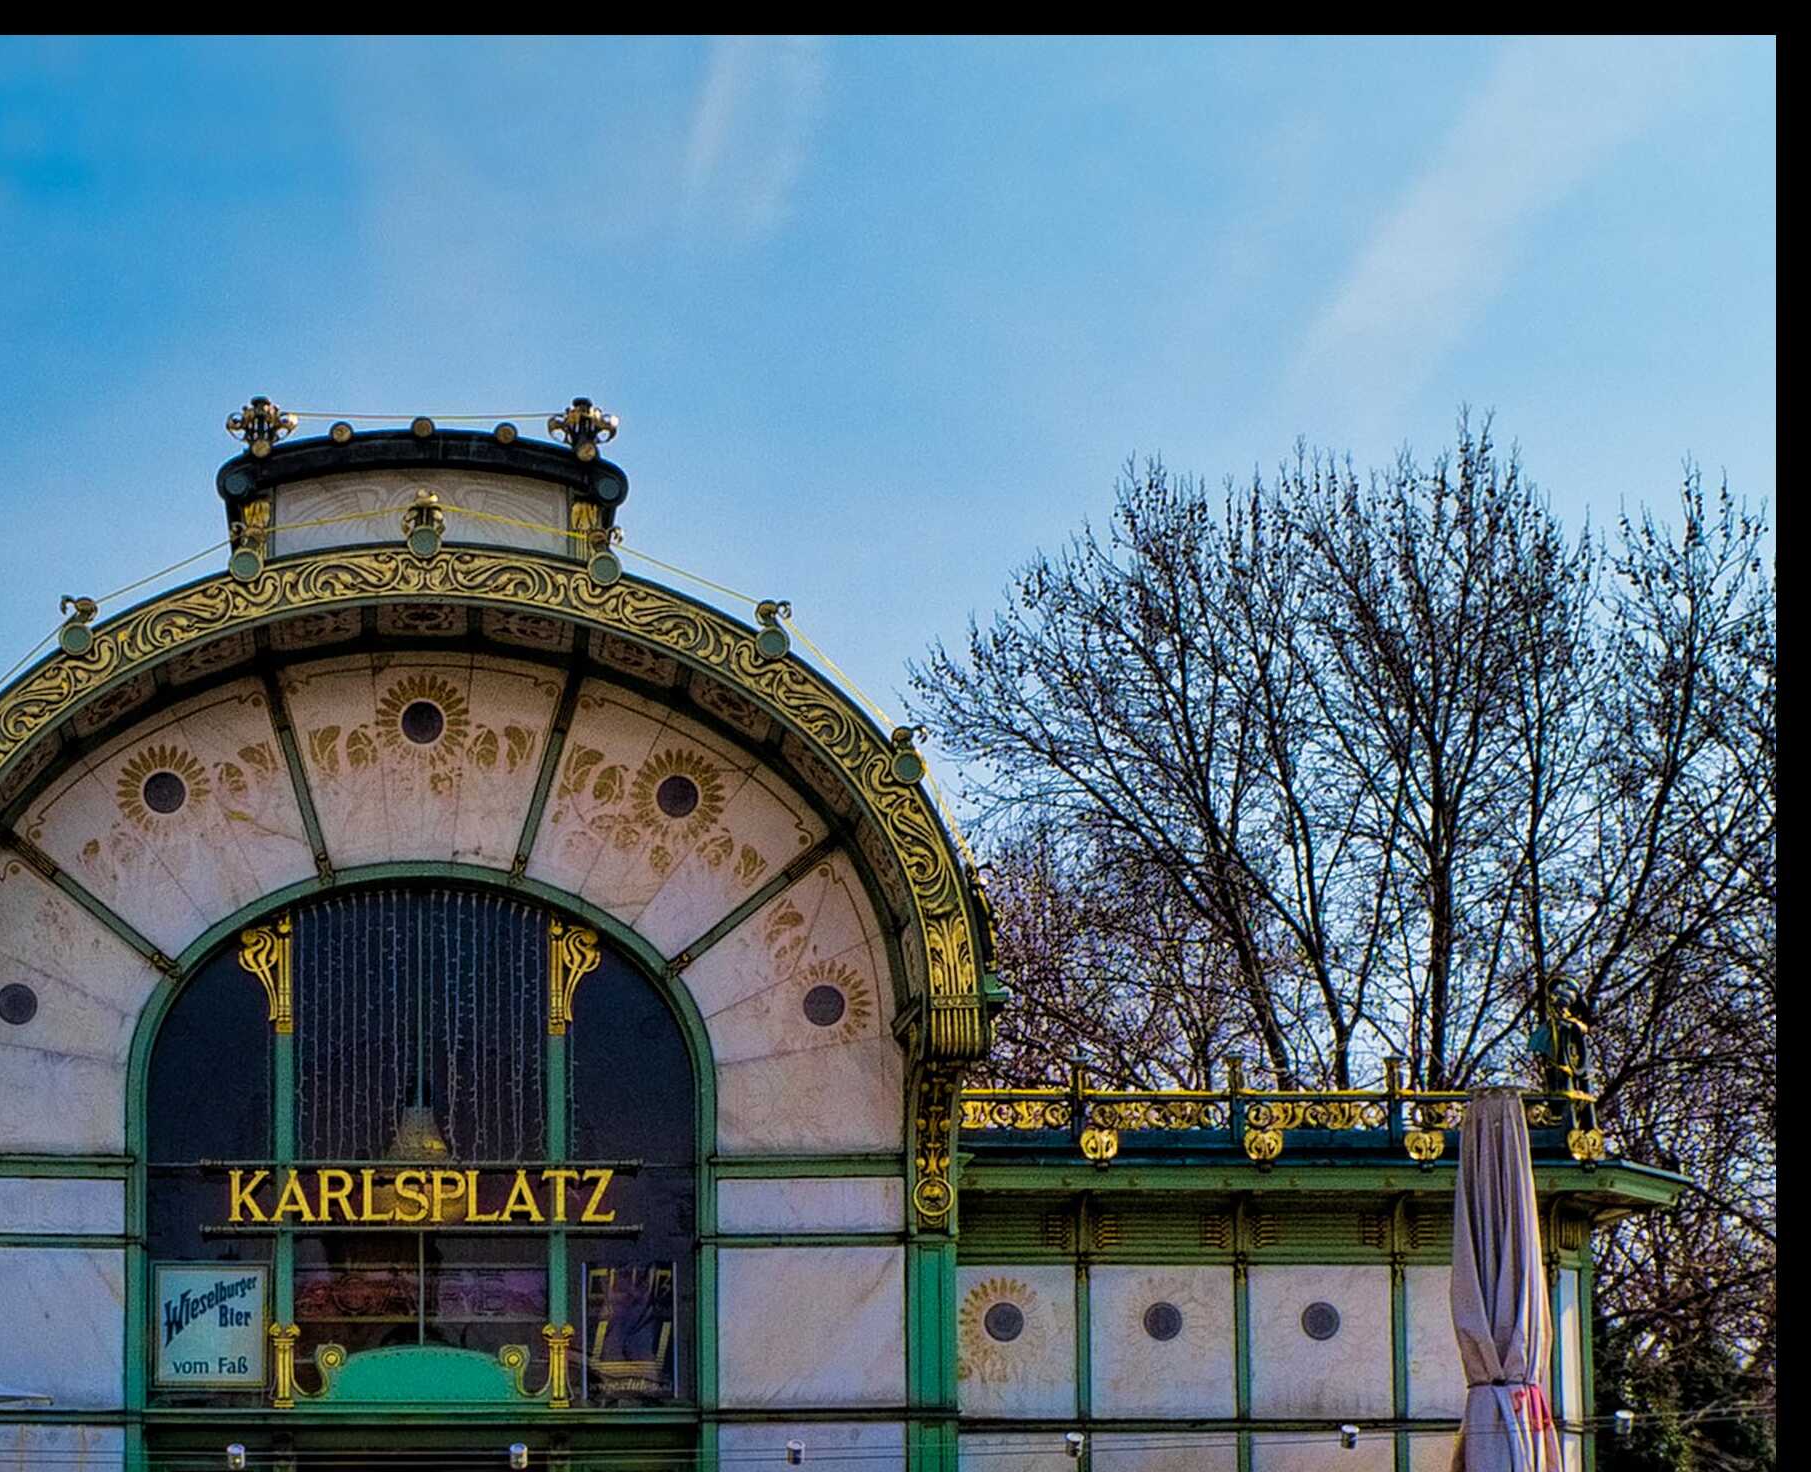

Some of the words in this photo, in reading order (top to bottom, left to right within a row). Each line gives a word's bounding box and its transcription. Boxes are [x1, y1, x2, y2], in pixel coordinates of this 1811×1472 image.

[228, 1168, 616, 1222] KARLSPLATZ
[164, 1276, 258, 1349] Wieselburger
[218, 1304, 252, 1328] Bier
[172, 1360, 210, 1375] vom
[218, 1355, 249, 1375] Faß
